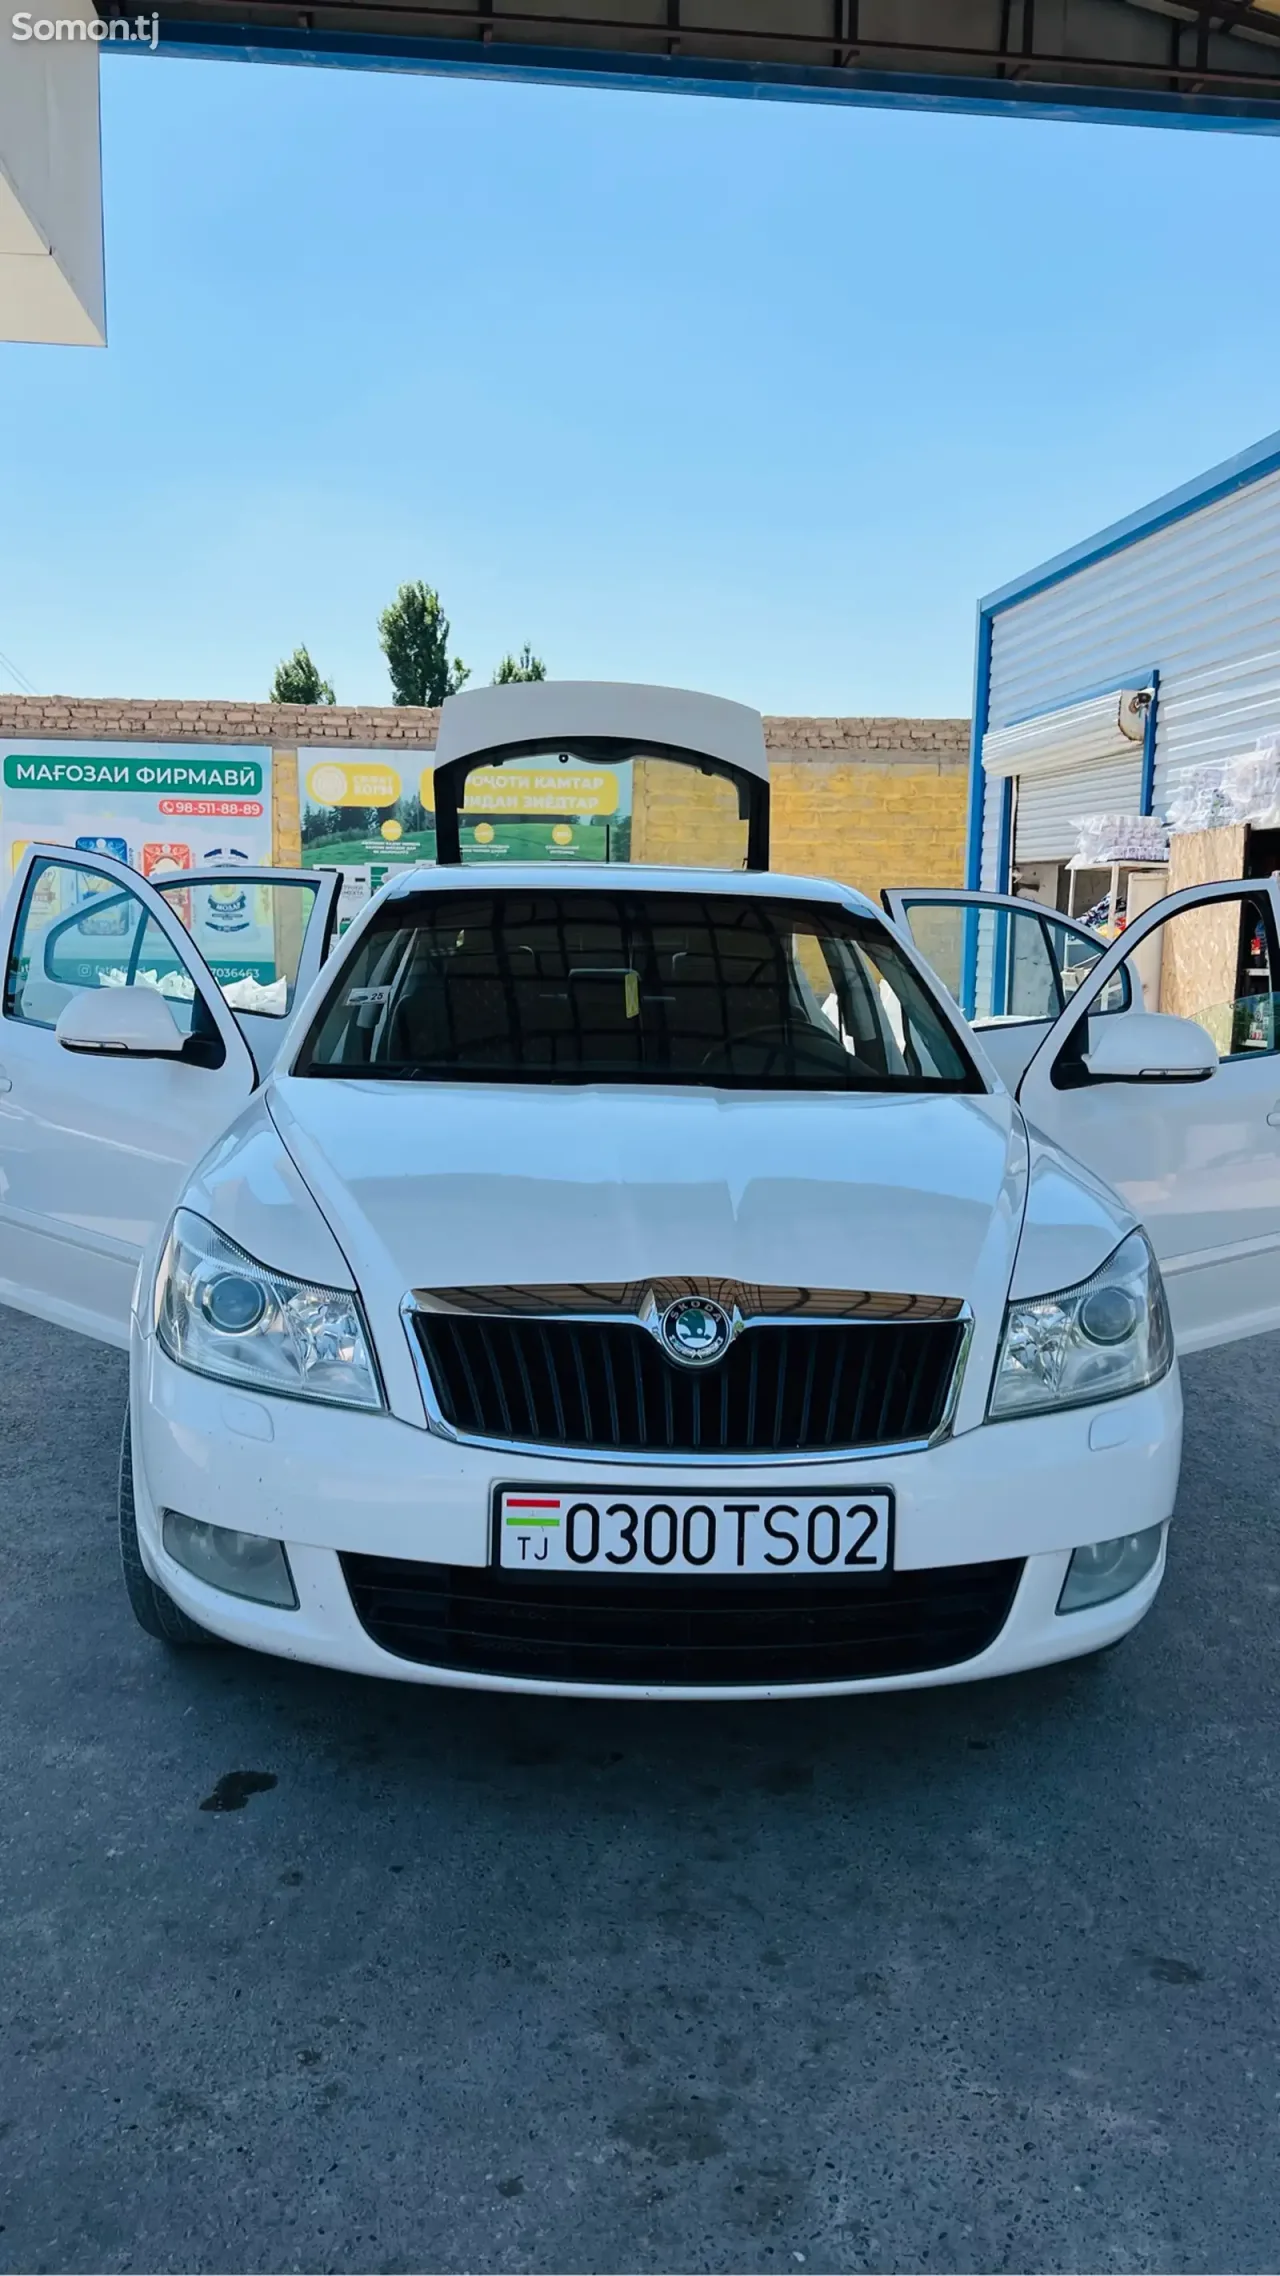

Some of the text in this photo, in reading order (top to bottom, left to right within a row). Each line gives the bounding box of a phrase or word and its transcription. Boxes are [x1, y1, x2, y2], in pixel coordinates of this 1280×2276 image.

[16, 763, 129, 783] МАҒОЗАИ
[534, 776, 604, 790] КАМТАР
[176, 802, 260, 815] 98-511-88-89
[210, 967, 260, 979] 7036463
[370, 992, 384, 1001] 25
[565, 1502, 879, 1566] 0300TS02
[516, 1536, 549, 1561] TJ
